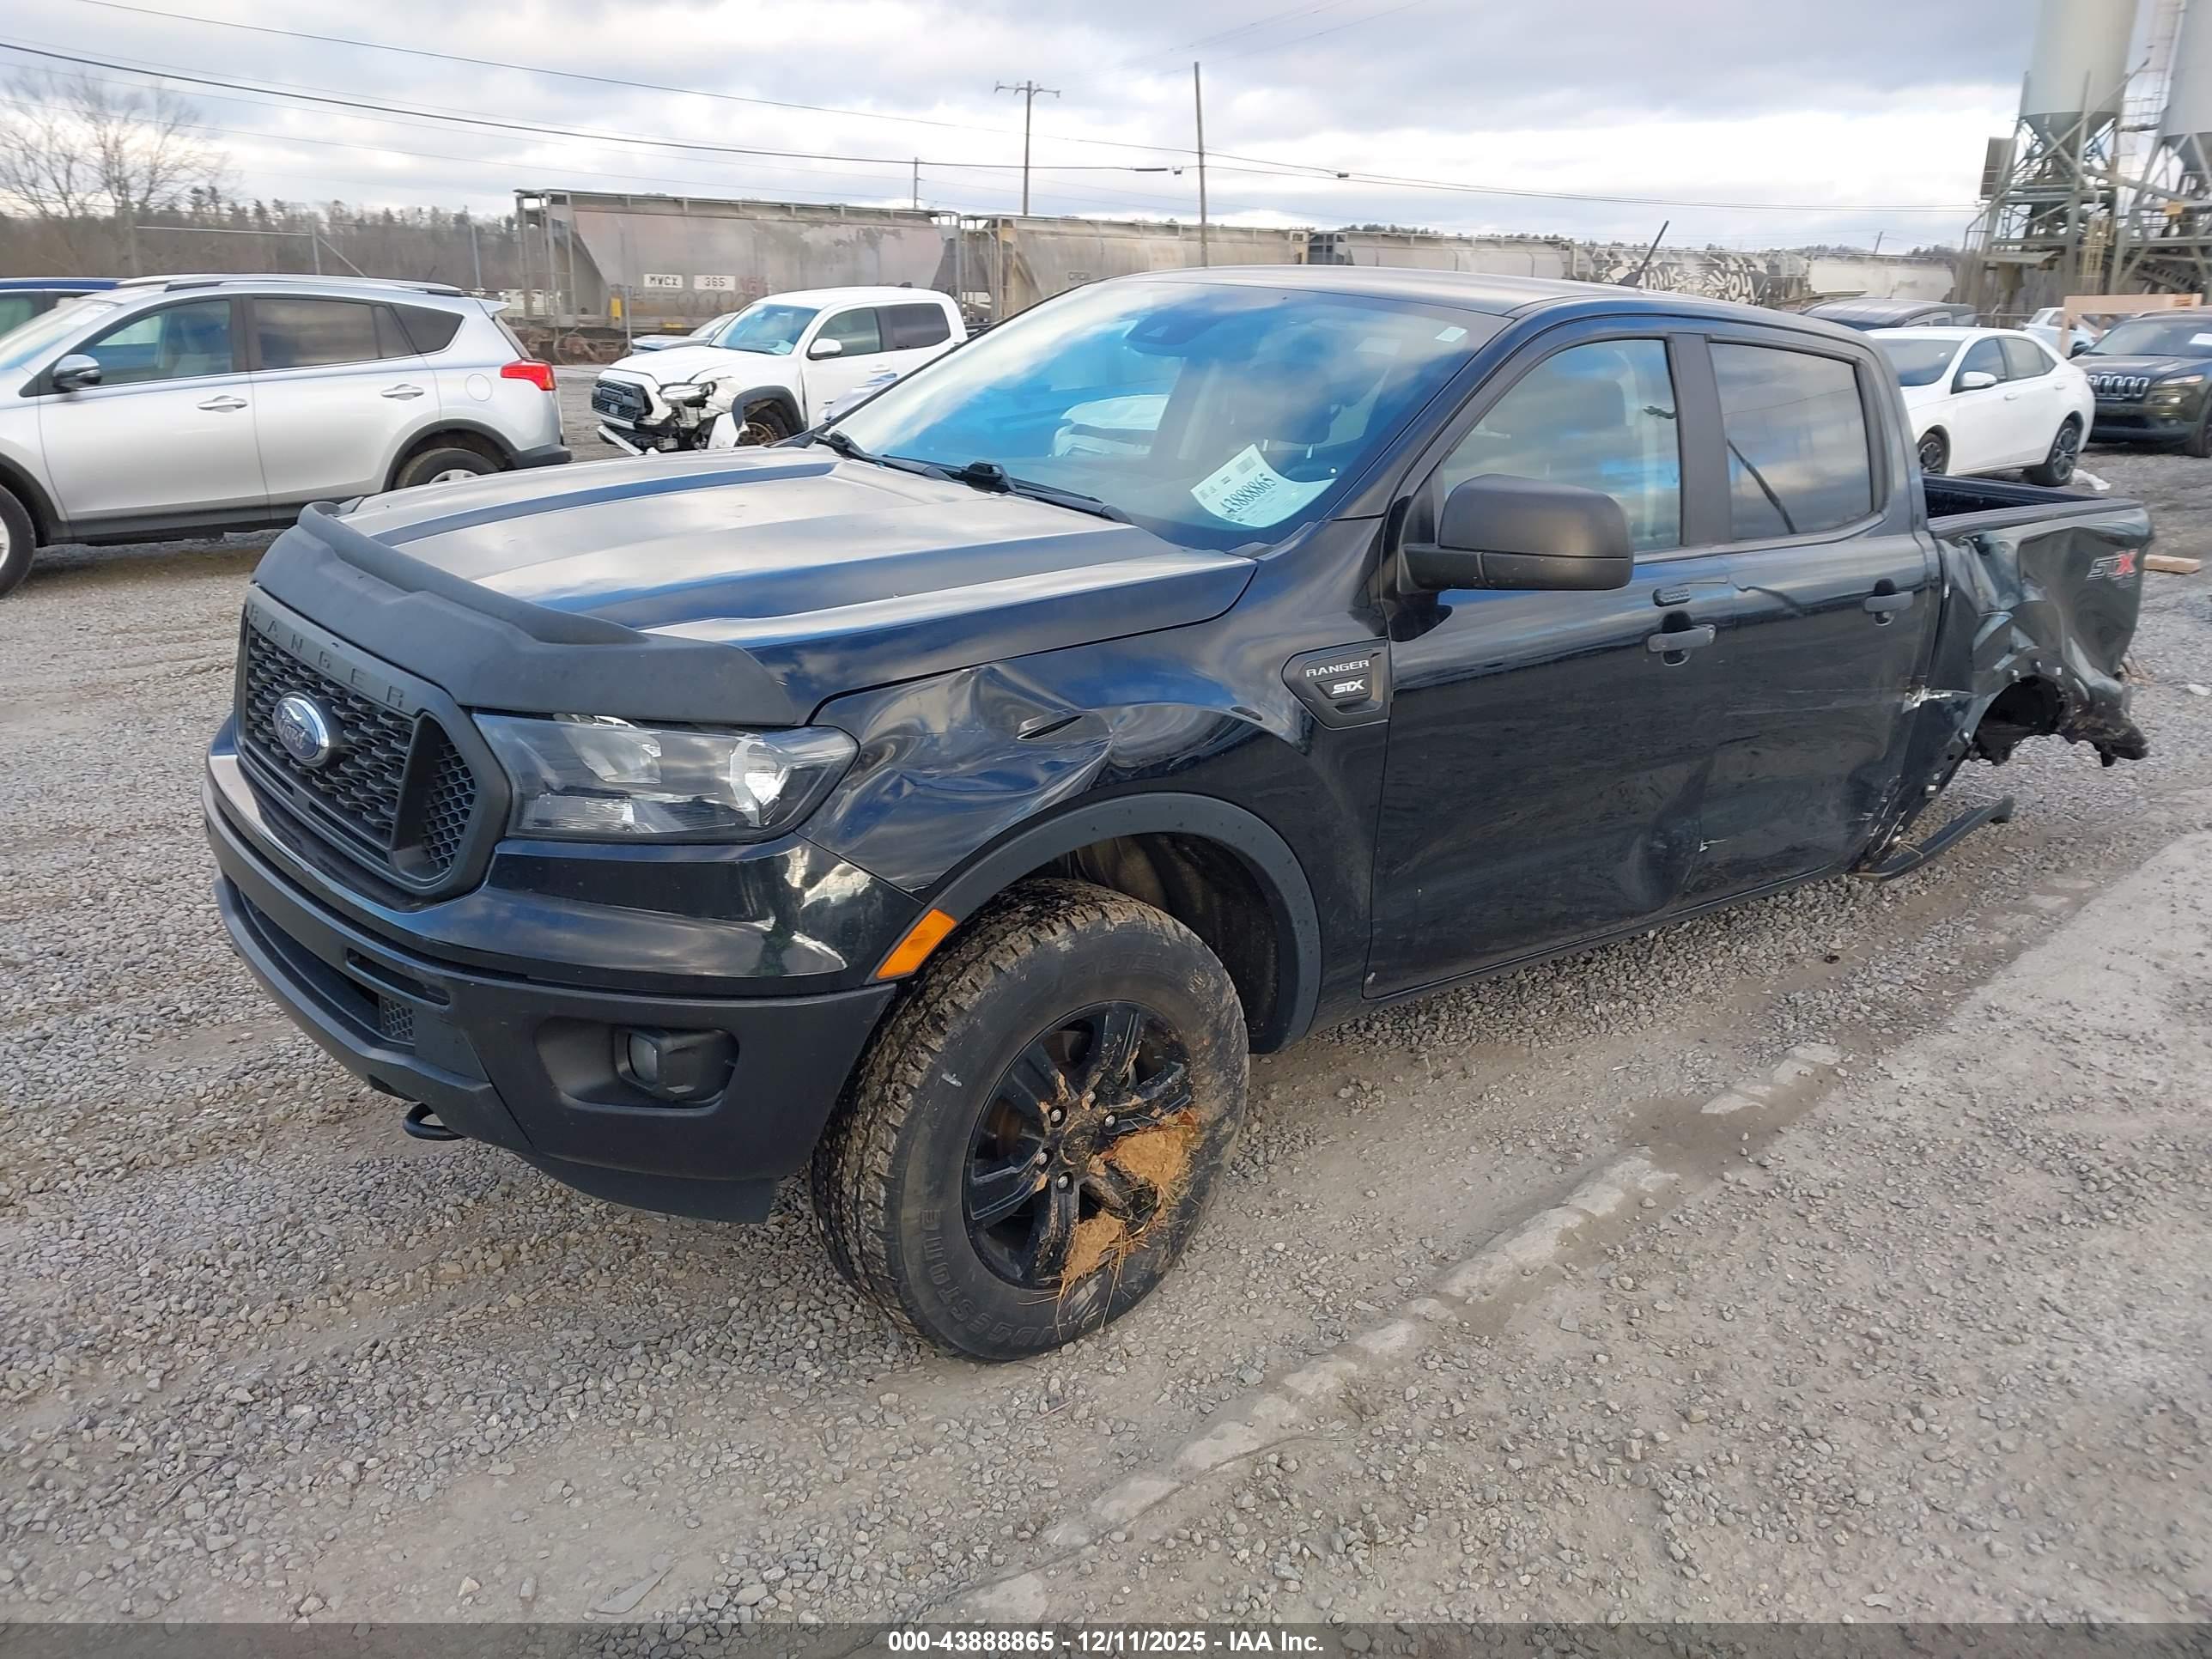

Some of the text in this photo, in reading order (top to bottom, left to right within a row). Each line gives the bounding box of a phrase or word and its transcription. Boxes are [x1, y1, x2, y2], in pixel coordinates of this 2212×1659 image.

[648, 275, 726, 288] MWCX 365
[1218, 472, 1279, 514] 43888865
[2085, 548, 2139, 581] STX
[248, 603, 405, 709] RANGER
[1305, 659, 1370, 678] RANGER
[1331, 678, 1366, 695] STX
[277, 702, 309, 750] Ford
[920, 1208, 1108, 1346] IDGESTONE
